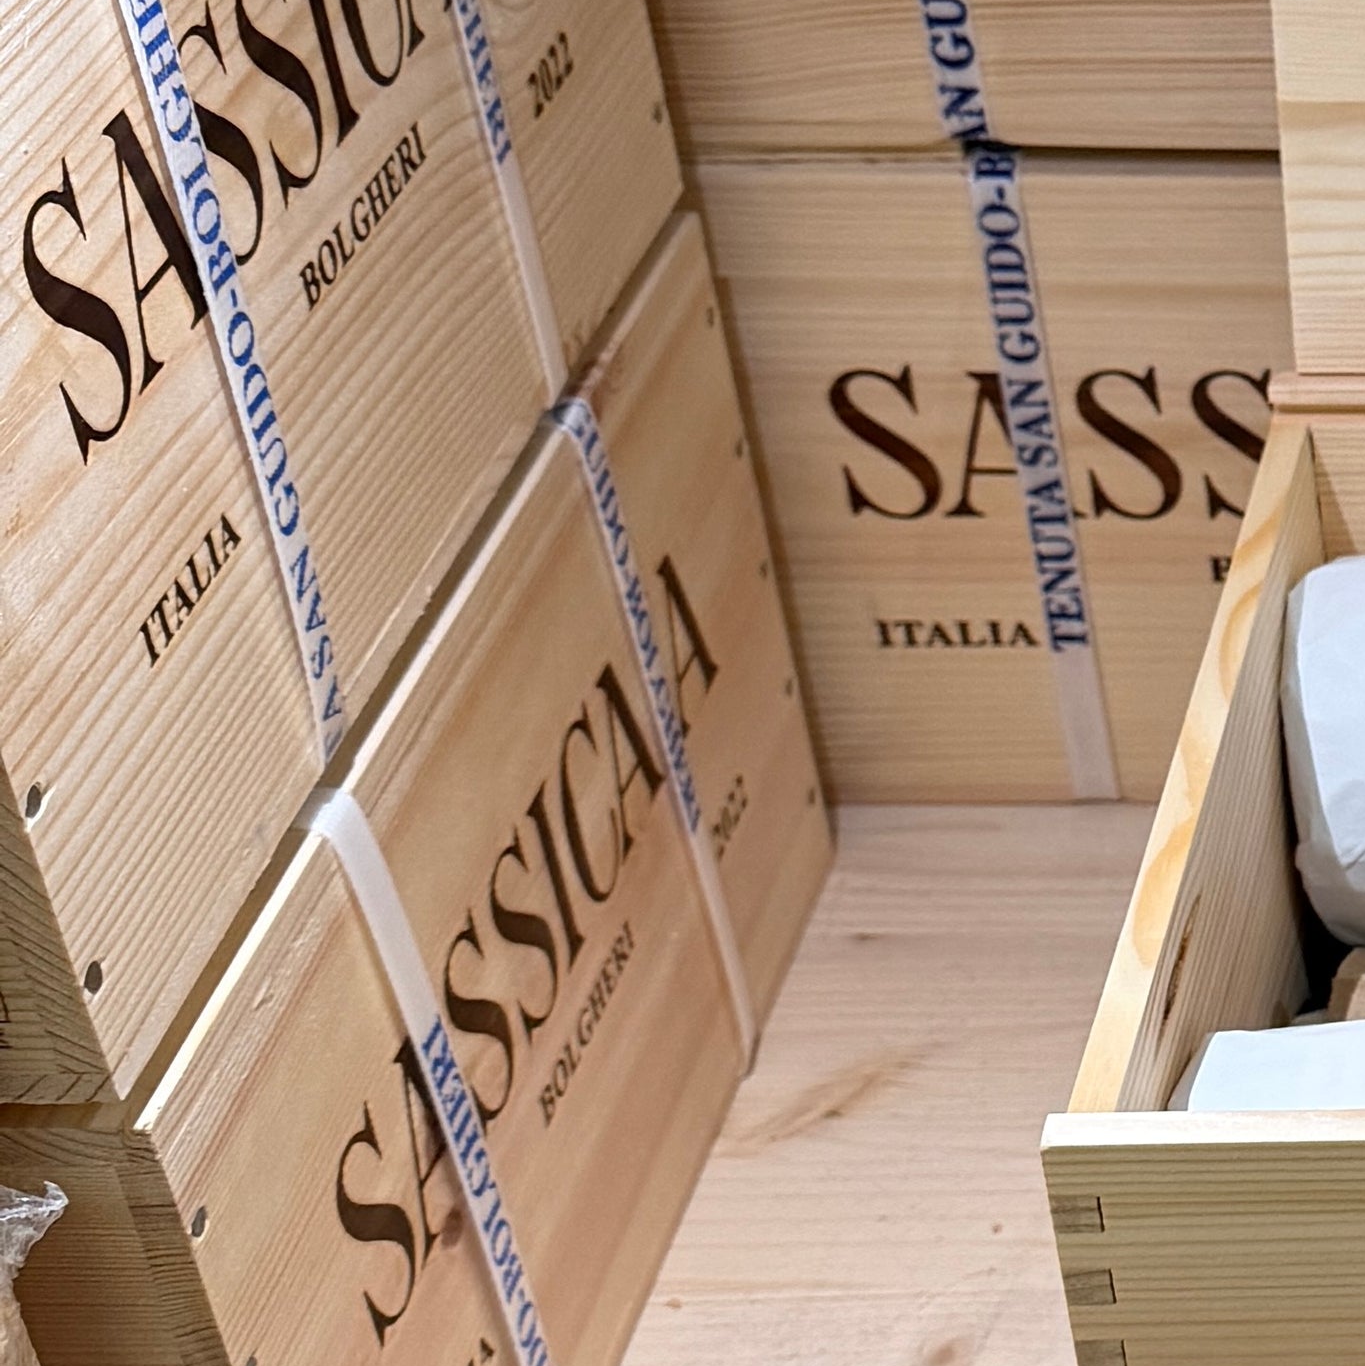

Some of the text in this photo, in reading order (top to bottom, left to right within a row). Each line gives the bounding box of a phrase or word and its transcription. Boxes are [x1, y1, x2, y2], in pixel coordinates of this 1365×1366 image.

[527, 33, 575, 119] 2022
[299, 122, 428, 312] BOLGHERI
[1006, 376, 1059, 469] SAN
[135, 512, 243, 669] ITALIA
[289, 545, 334, 680] SAN
[877, 618, 1039, 647] ITALIA
[1024, 474, 1089, 651] TENUTA
[538, 920, 636, 1129] BOLGHERI
